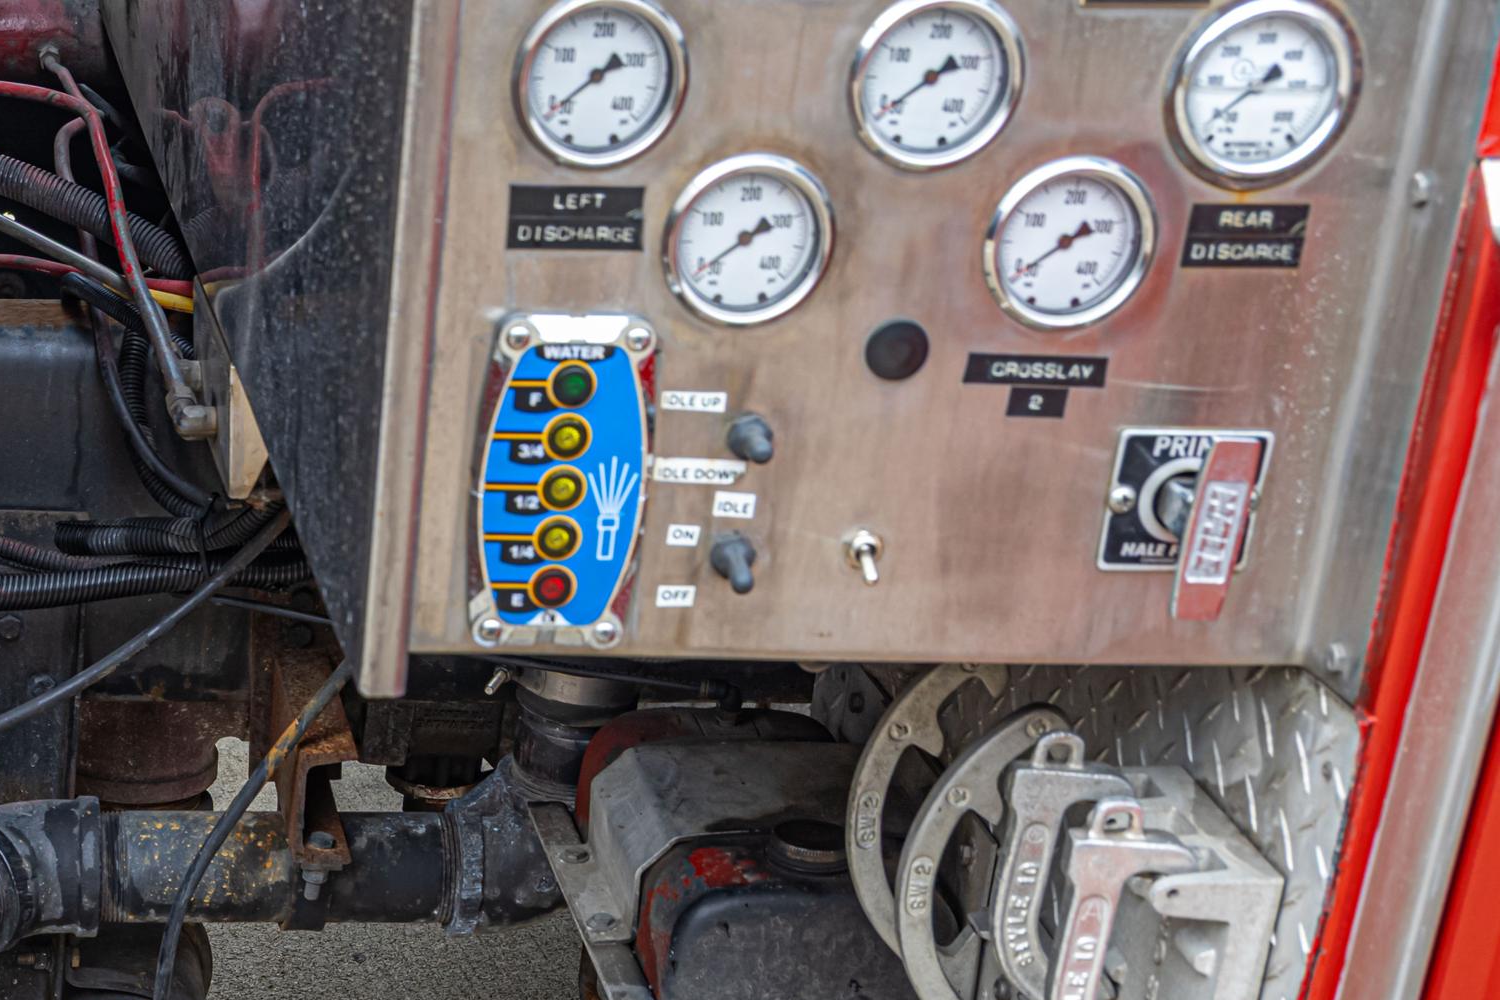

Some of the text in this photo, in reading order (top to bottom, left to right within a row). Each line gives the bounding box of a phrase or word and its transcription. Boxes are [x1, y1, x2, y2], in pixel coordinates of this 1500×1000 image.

[553, 193, 607, 210] LEFT
[1218, 210, 1275, 230] REAR
[517, 225, 636, 243] DISCHARGE
[1190, 243, 1295, 262] DISCARGE
[542, 346, 605, 360] WATER
[991, 361, 1094, 379] CROSSLAY
[529, 393, 542, 407] F
[664, 394, 721, 408] IDLE UP
[1028, 394, 1044, 411] 2
[518, 443, 545, 459] 3/4
[658, 468, 689, 480] IDLE
[513, 495, 540, 510] 1/2
[718, 501, 750, 514] IDLE
[672, 528, 695, 539] ON
[509, 545, 535, 559] 1/4
[1120, 542, 1167, 557] HALE
[511, 593, 524, 607] E
[661, 589, 690, 601] OFF
[915, 864, 931, 876] 2
